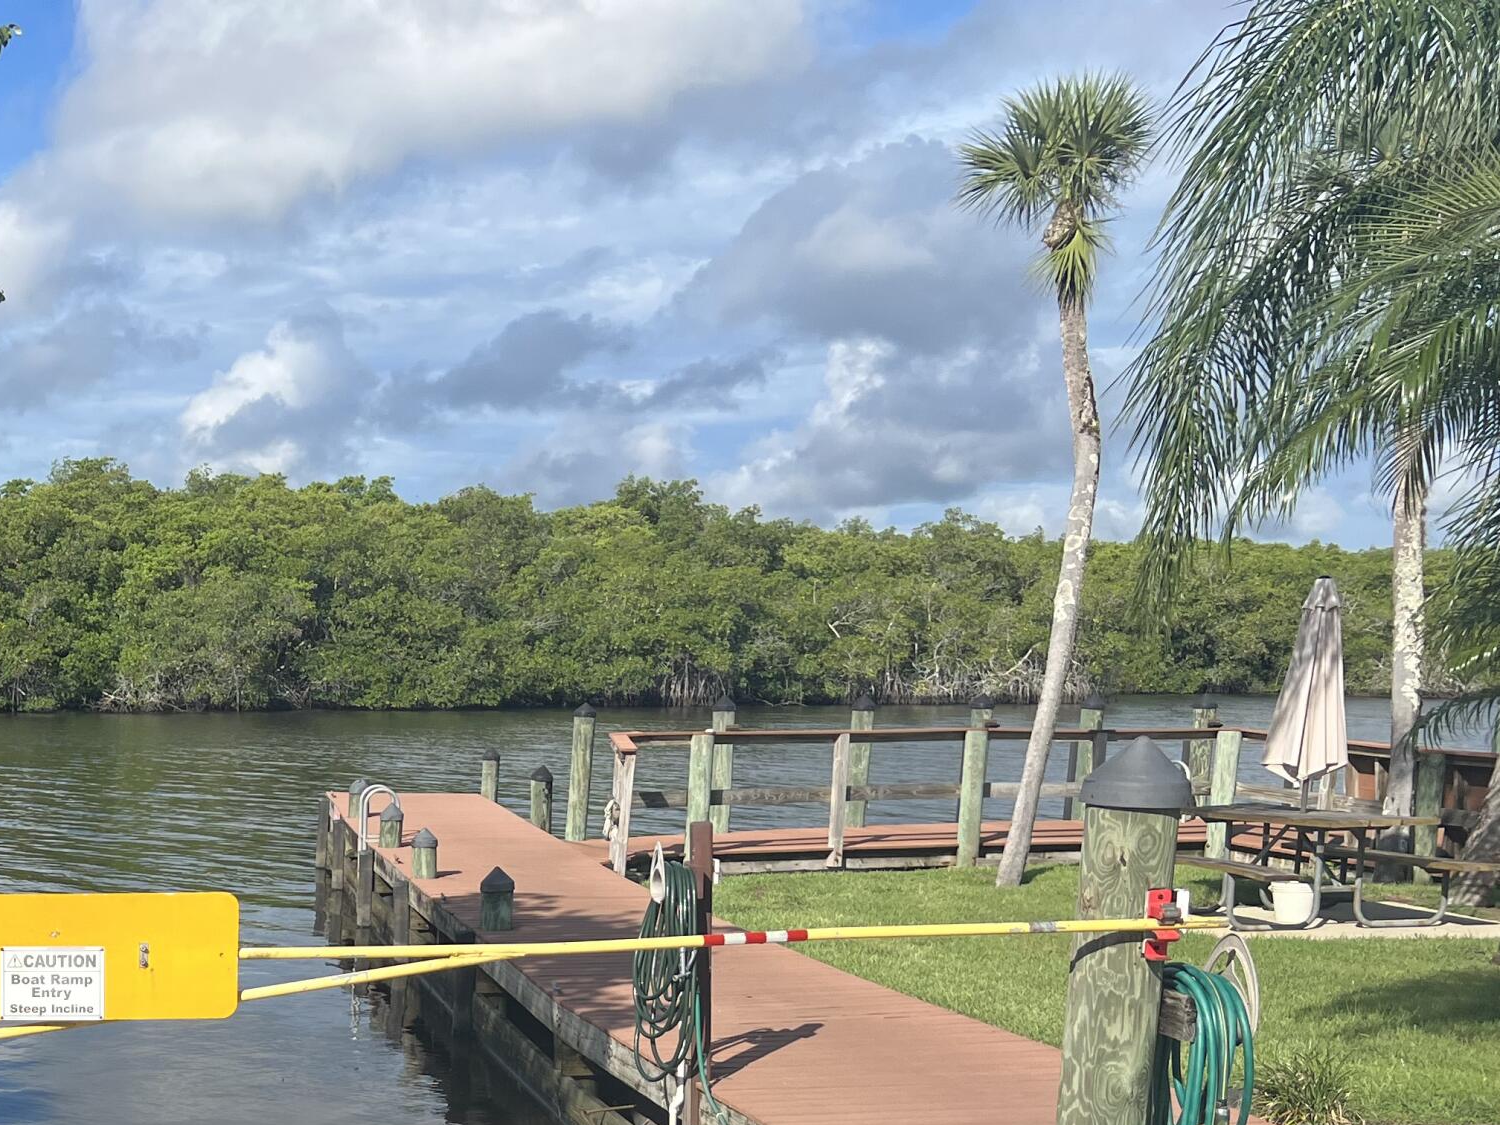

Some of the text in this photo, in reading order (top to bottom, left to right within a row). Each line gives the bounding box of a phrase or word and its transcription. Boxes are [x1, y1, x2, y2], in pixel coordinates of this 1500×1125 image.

[23, 954, 97, 967] CAUTION
[11, 974, 93, 987] Boat Ramp
[31, 987, 72, 1000] Entry
[10, 1004, 94, 1016] Steep Incline
